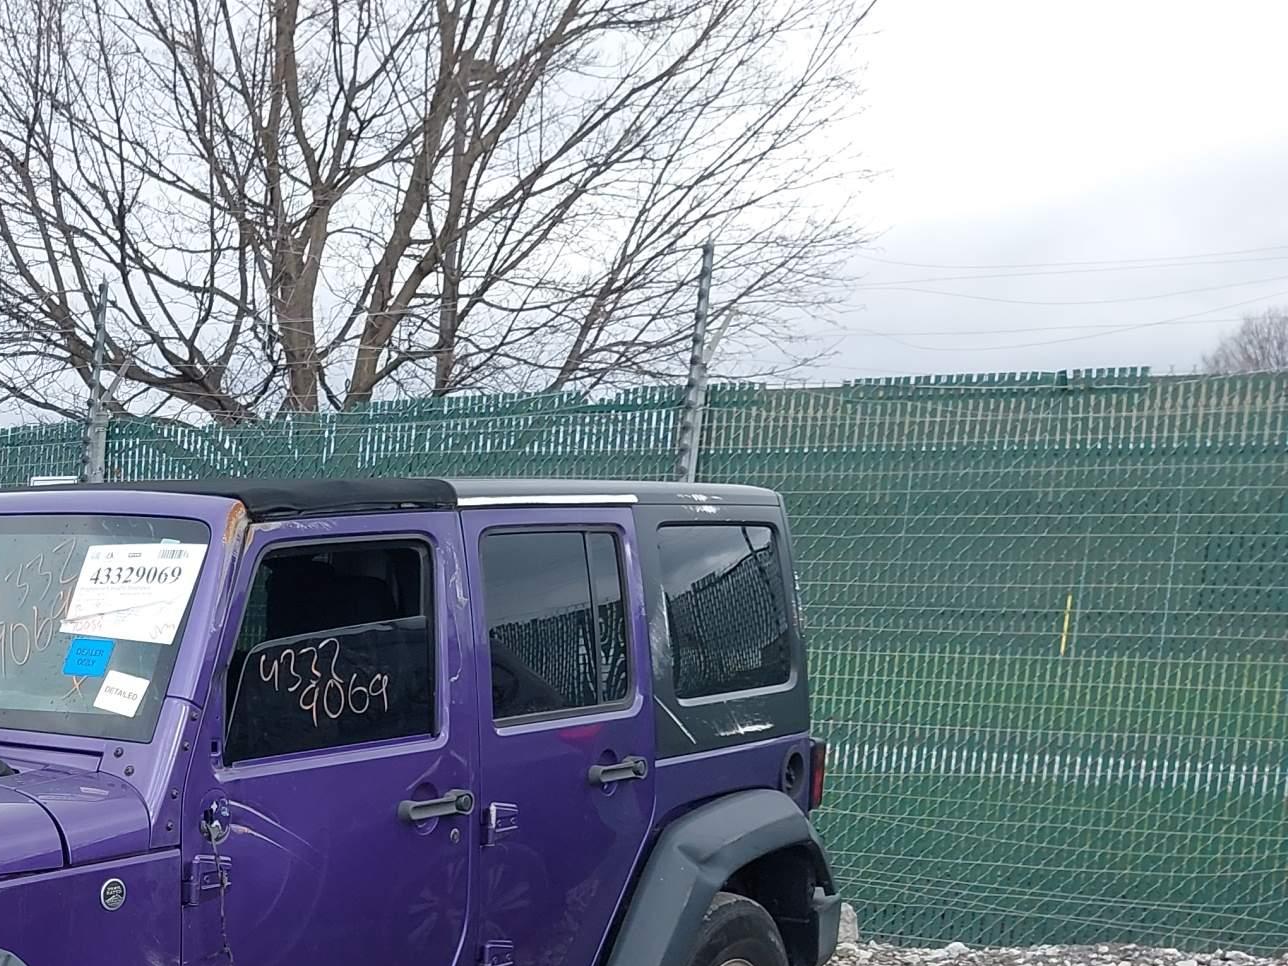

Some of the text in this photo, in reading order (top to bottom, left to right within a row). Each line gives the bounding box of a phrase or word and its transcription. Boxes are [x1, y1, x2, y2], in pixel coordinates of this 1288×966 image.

[89, 566, 183, 585] 43329069
[75, 647, 105, 657] DEALER
[104, 685, 138, 701] DETAILED
[299, 673, 389, 728] 9069
